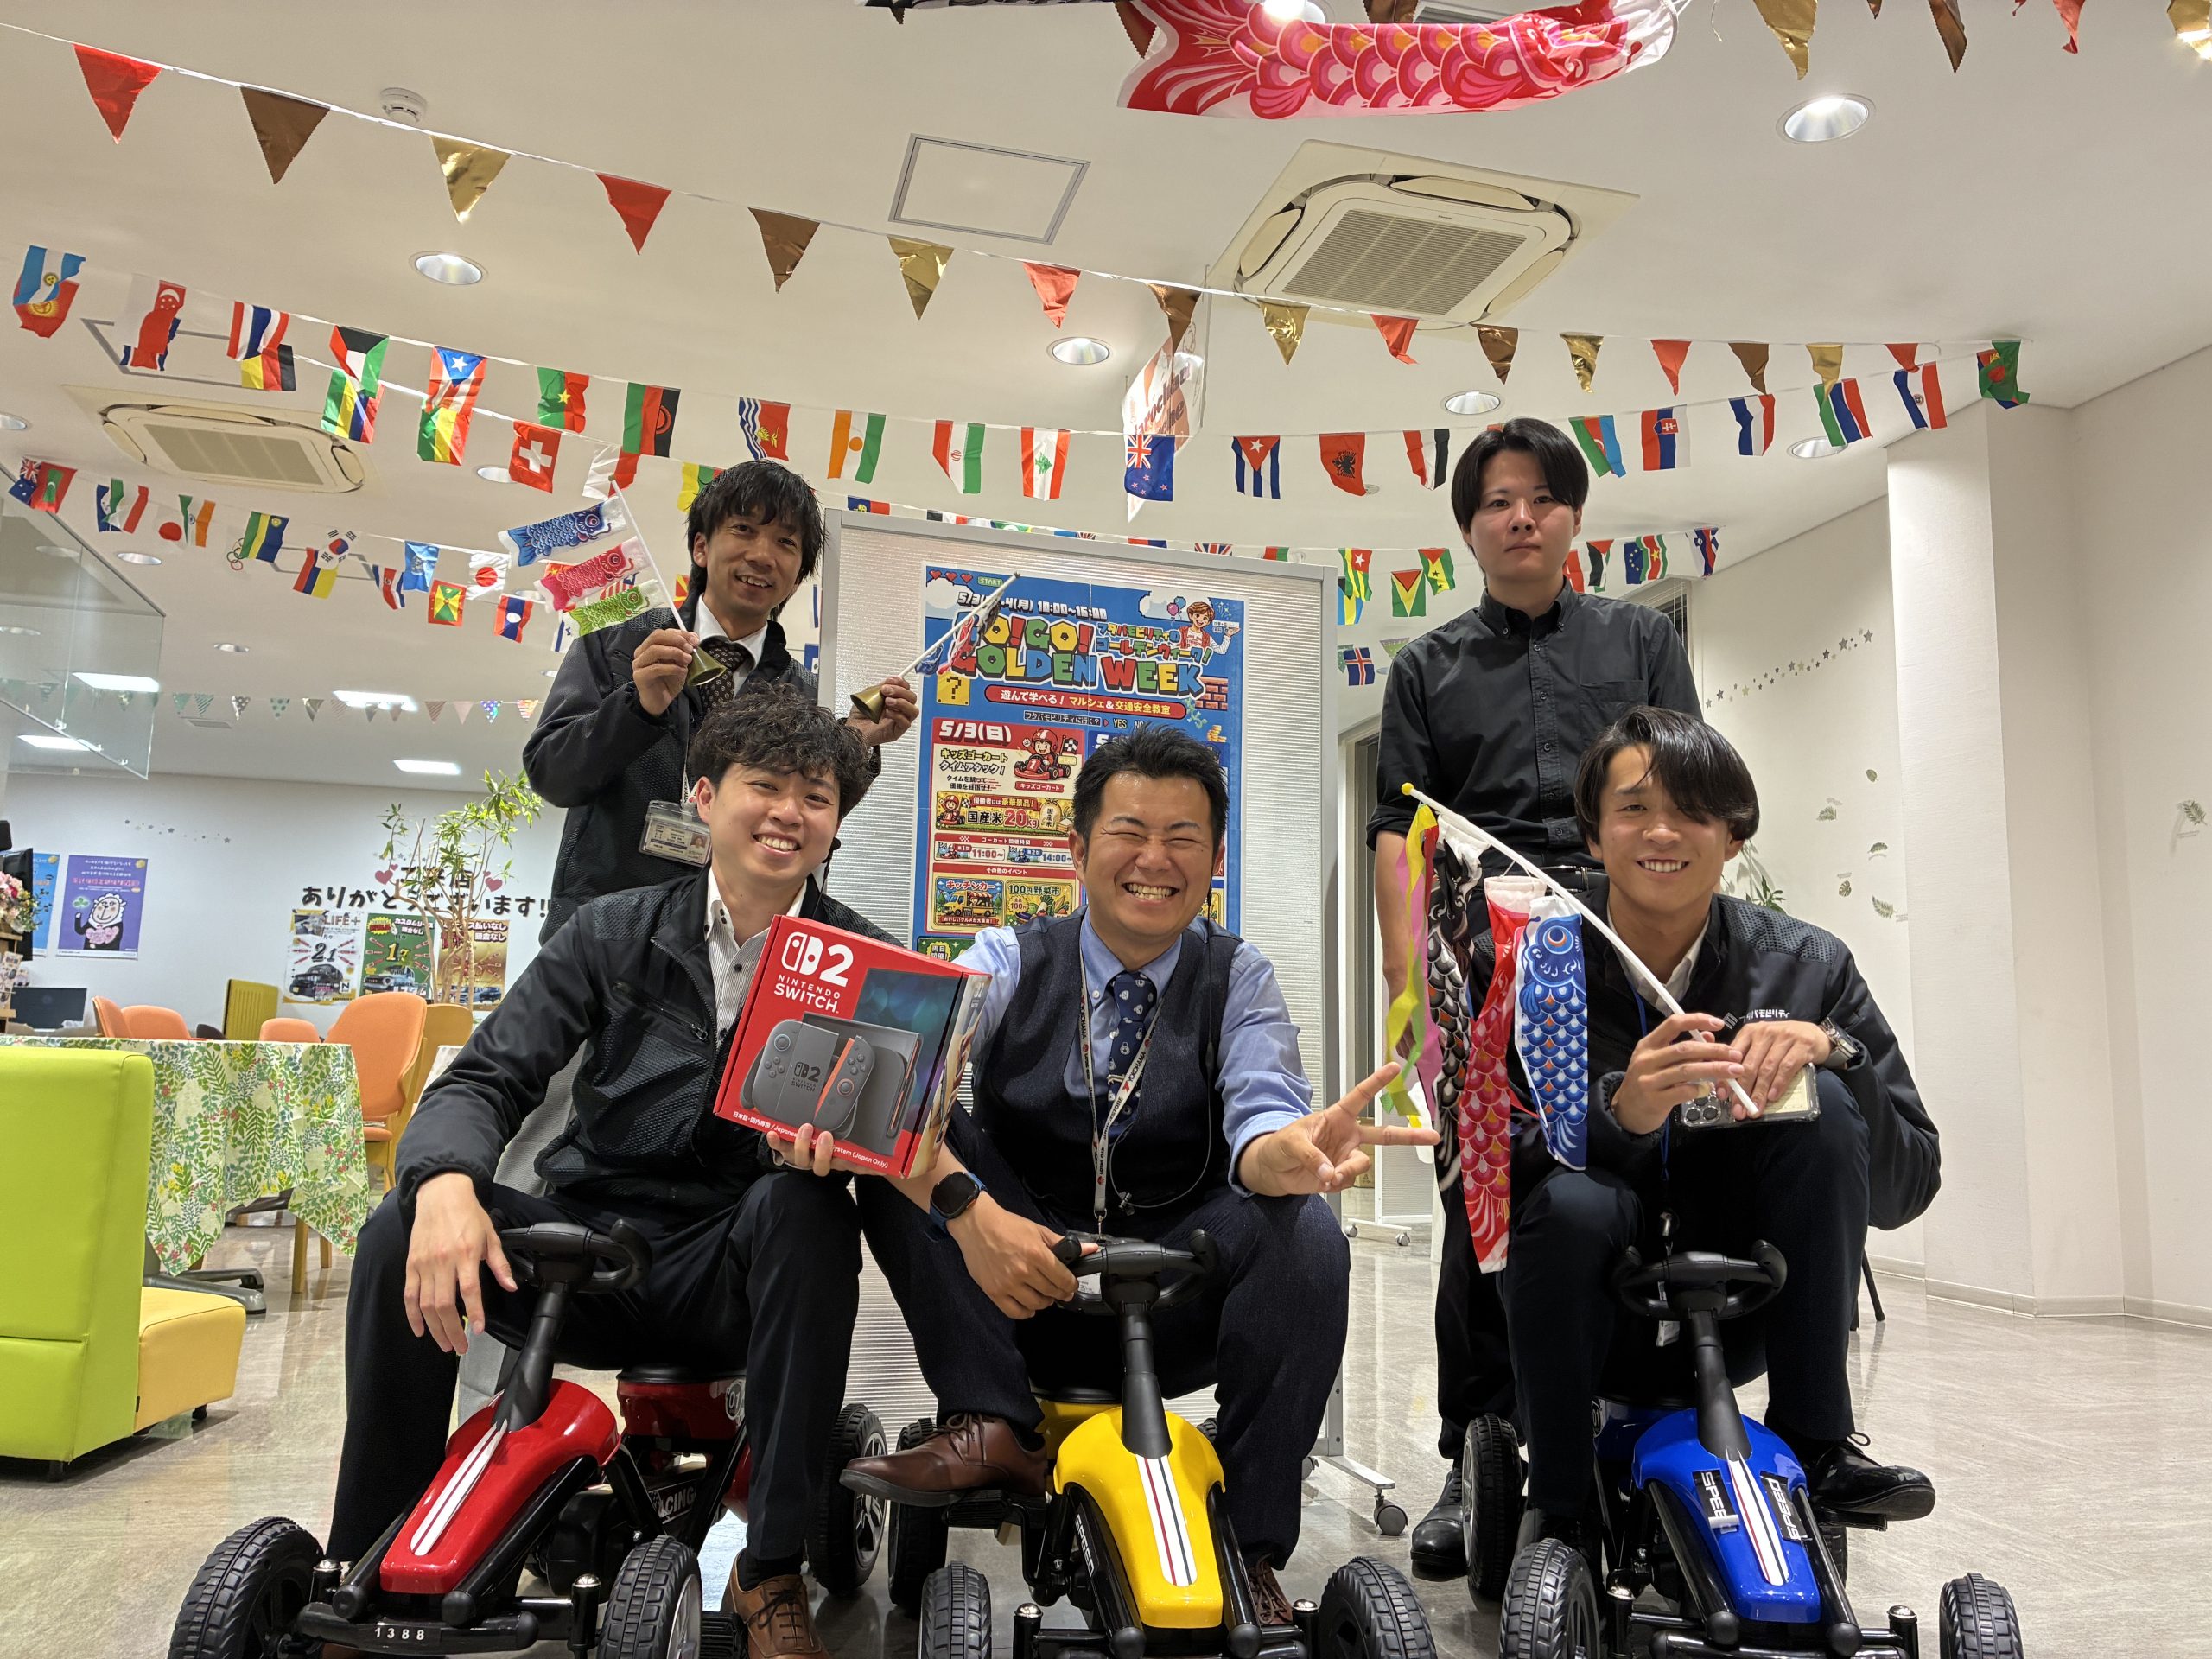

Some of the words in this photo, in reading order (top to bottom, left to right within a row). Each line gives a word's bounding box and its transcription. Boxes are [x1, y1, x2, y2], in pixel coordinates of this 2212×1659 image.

[1097, 623, 1180, 643] フタバモビリティの
[1101, 657, 1202, 697] WEEK
[939, 721, 1012, 744] 5/3(日)
[1113, 719, 1127, 728] YES
[941, 748, 1008, 762] キッズゴーカート
[986, 867, 1027, 875] その他のイベント
[946, 880, 995, 891] キッチンカー
[1008, 885, 1060, 895] 100円野菜市
[773, 982, 839, 1013] SWITCH
[778, 975, 841, 1000] NINTENDO
[1128, 1052, 1147, 1082] YOKOHAMA
[833, 1146, 852, 1155] ystem
[872, 1159, 888, 1168] Only)
[658, 1486, 696, 1518] ACING
[1768, 1478, 1801, 1541] SPEED
[1075, 1514, 1095, 1577] SPEED
[375, 1627, 424, 1640] 1388
